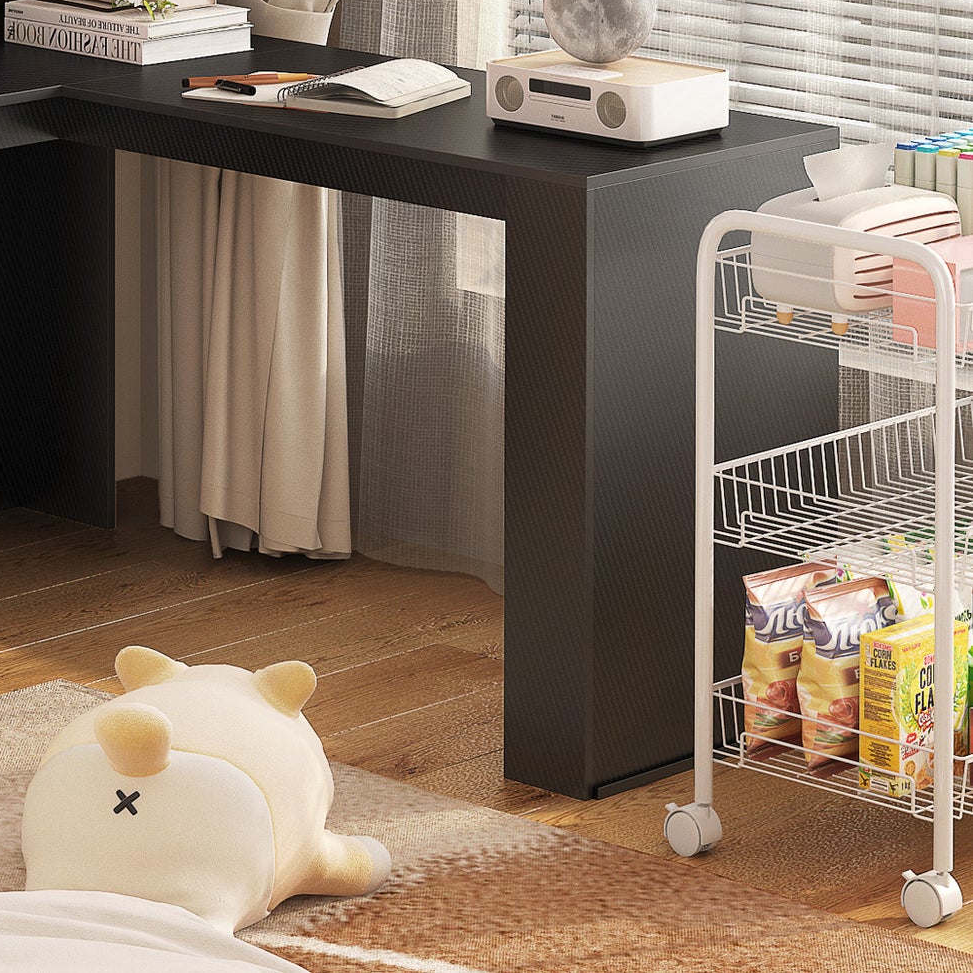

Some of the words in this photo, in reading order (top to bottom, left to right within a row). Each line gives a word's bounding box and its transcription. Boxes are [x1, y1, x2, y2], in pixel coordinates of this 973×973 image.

[59, 15, 87, 26] BEAUTY
[87, 19, 97, 28] OF
[98, 21, 124, 33] ALLURE
[125, 24, 140, 35] THE
[873, 648, 892, 660] CORN
[870, 658, 897, 671] FLAKES
[919, 663, 935, 690] CO
[915, 688, 935, 716] FLA
